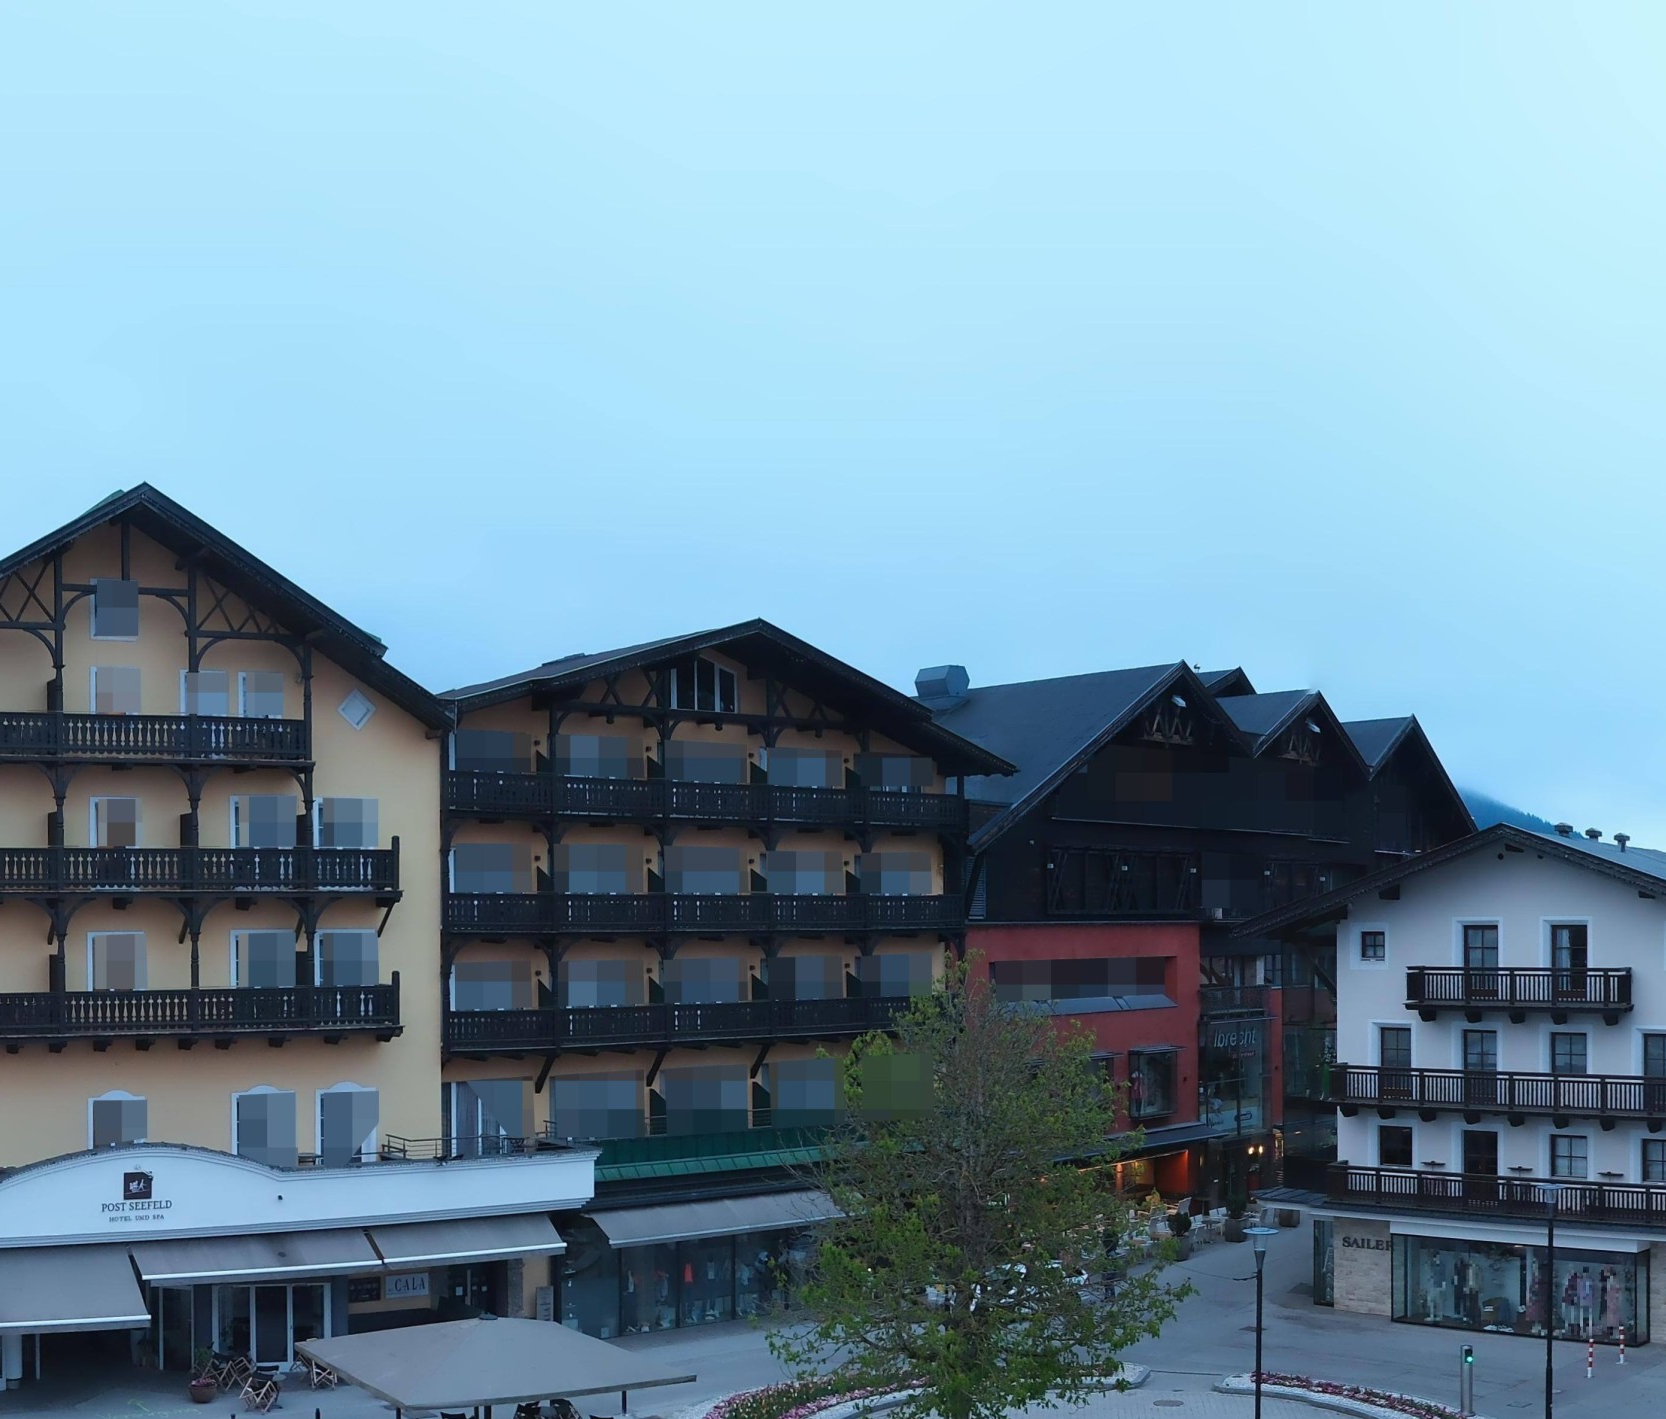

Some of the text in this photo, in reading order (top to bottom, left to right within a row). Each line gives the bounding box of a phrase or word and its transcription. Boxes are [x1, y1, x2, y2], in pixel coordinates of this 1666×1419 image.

[101, 1200, 172, 1212] POST SEEFELD
[395, 1277, 425, 1292] CALA
